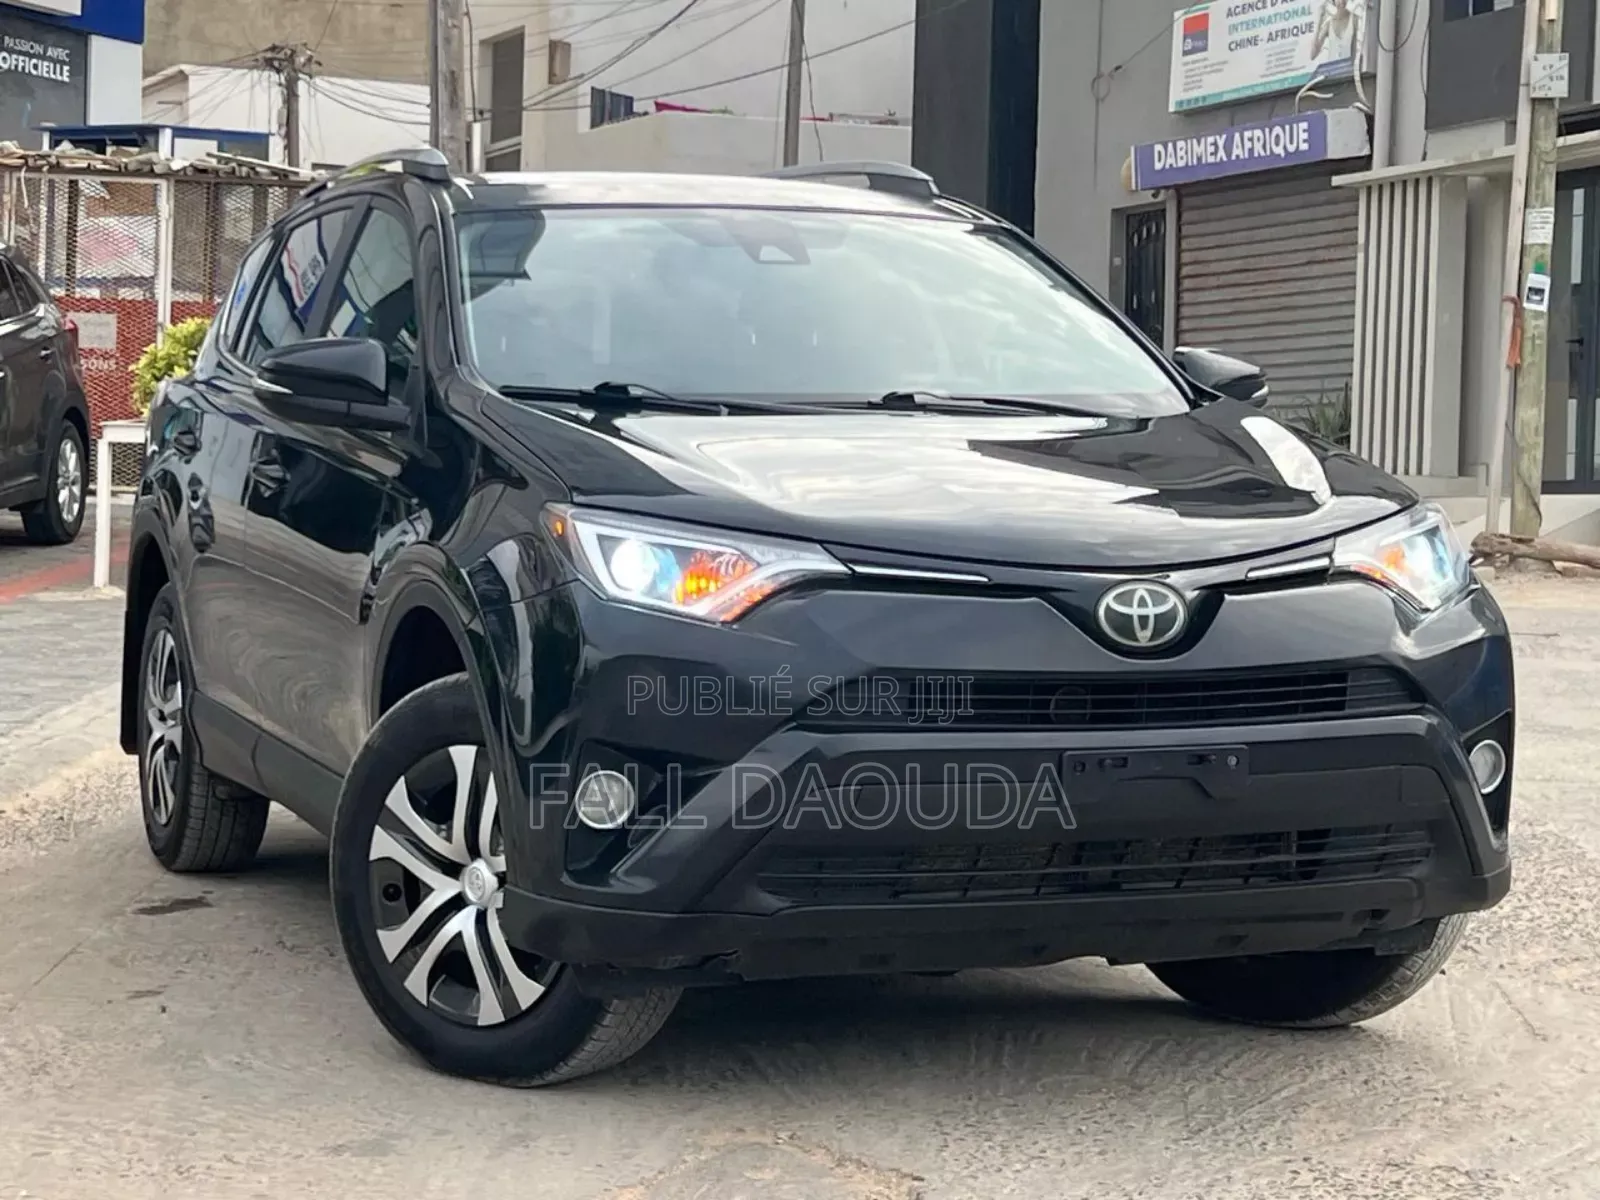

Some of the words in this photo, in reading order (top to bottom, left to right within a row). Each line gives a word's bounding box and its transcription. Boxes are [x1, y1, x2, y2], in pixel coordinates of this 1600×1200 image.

[1226, 0, 1268, 18] AGENCE
[1228, 4, 1313, 35] INTERNATIONAL
[1267, 21, 1315, 43] AFRIQUE
[4, 35, 44, 55] PASSION
[46, 46, 70, 61] AVEC
[0, 51, 70, 83] OFFICIELLE
[1153, 134, 1227, 170] DABIMEX
[1231, 121, 1309, 159] AFRIQUE
